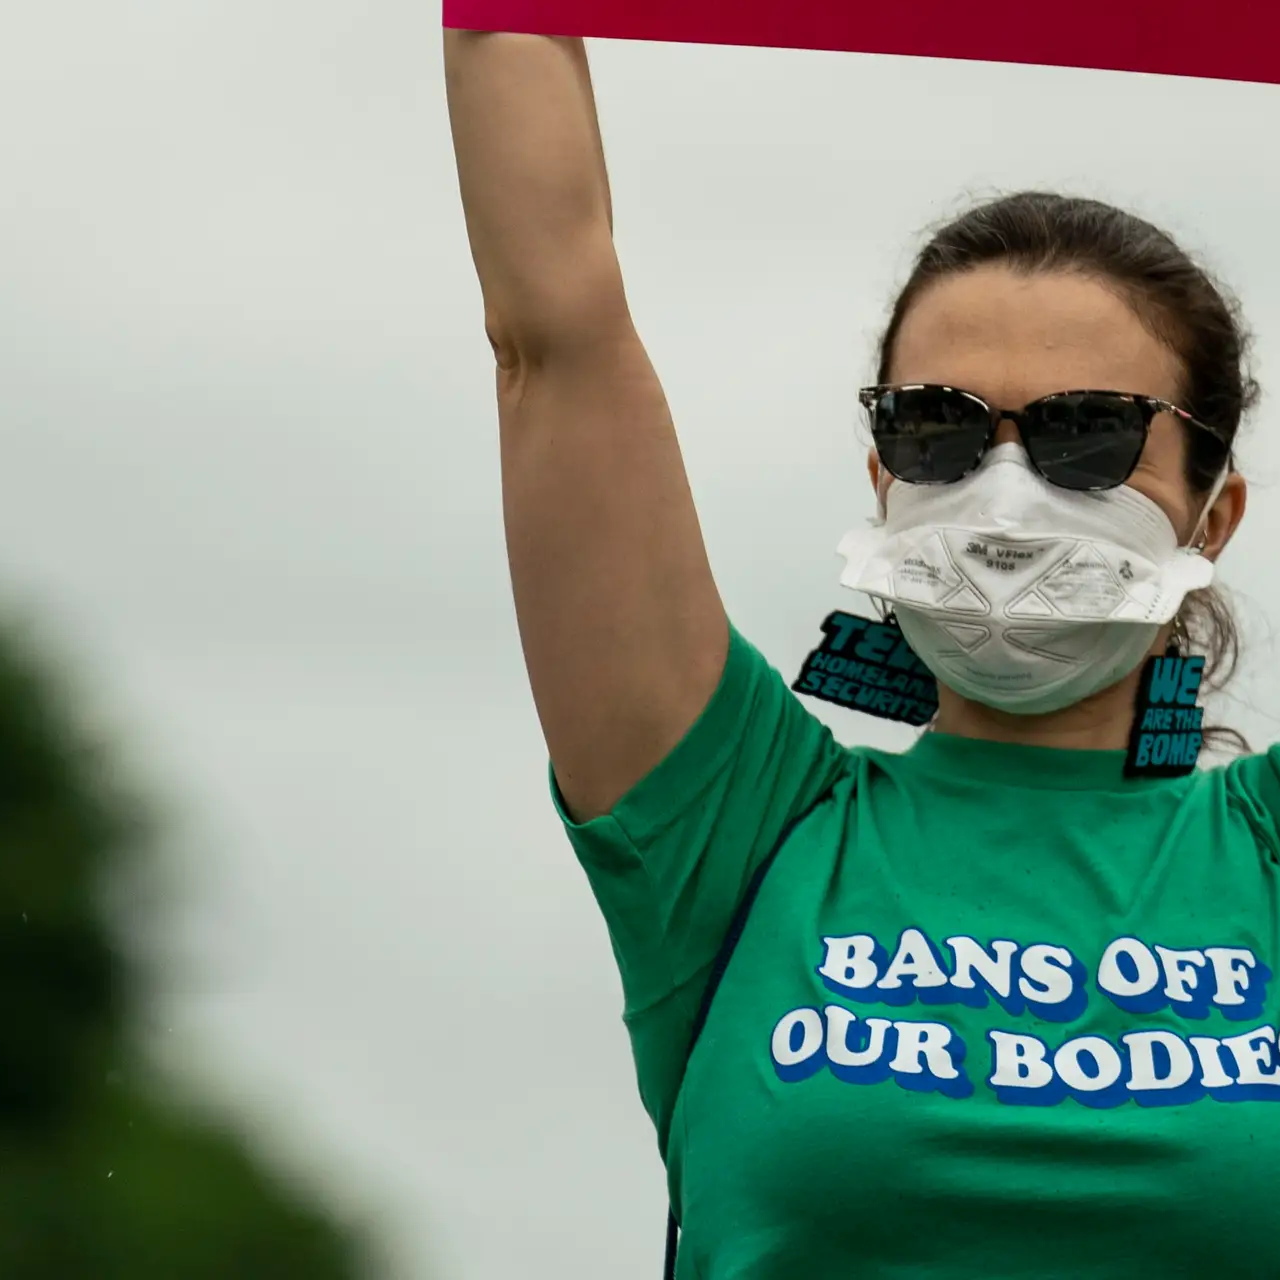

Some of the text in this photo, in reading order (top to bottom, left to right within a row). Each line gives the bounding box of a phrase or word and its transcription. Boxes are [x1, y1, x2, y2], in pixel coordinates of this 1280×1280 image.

[966, 542, 988, 556] 3M
[799, 669, 937, 723] SECURITY
[1148, 657, 1205, 706] WE
[1139, 708, 1203, 731] ARE THE
[1135, 732, 1202, 768] BOMB
[818, 928, 1261, 1010] BANS OFF
[771, 1005, 962, 1083] OUR
